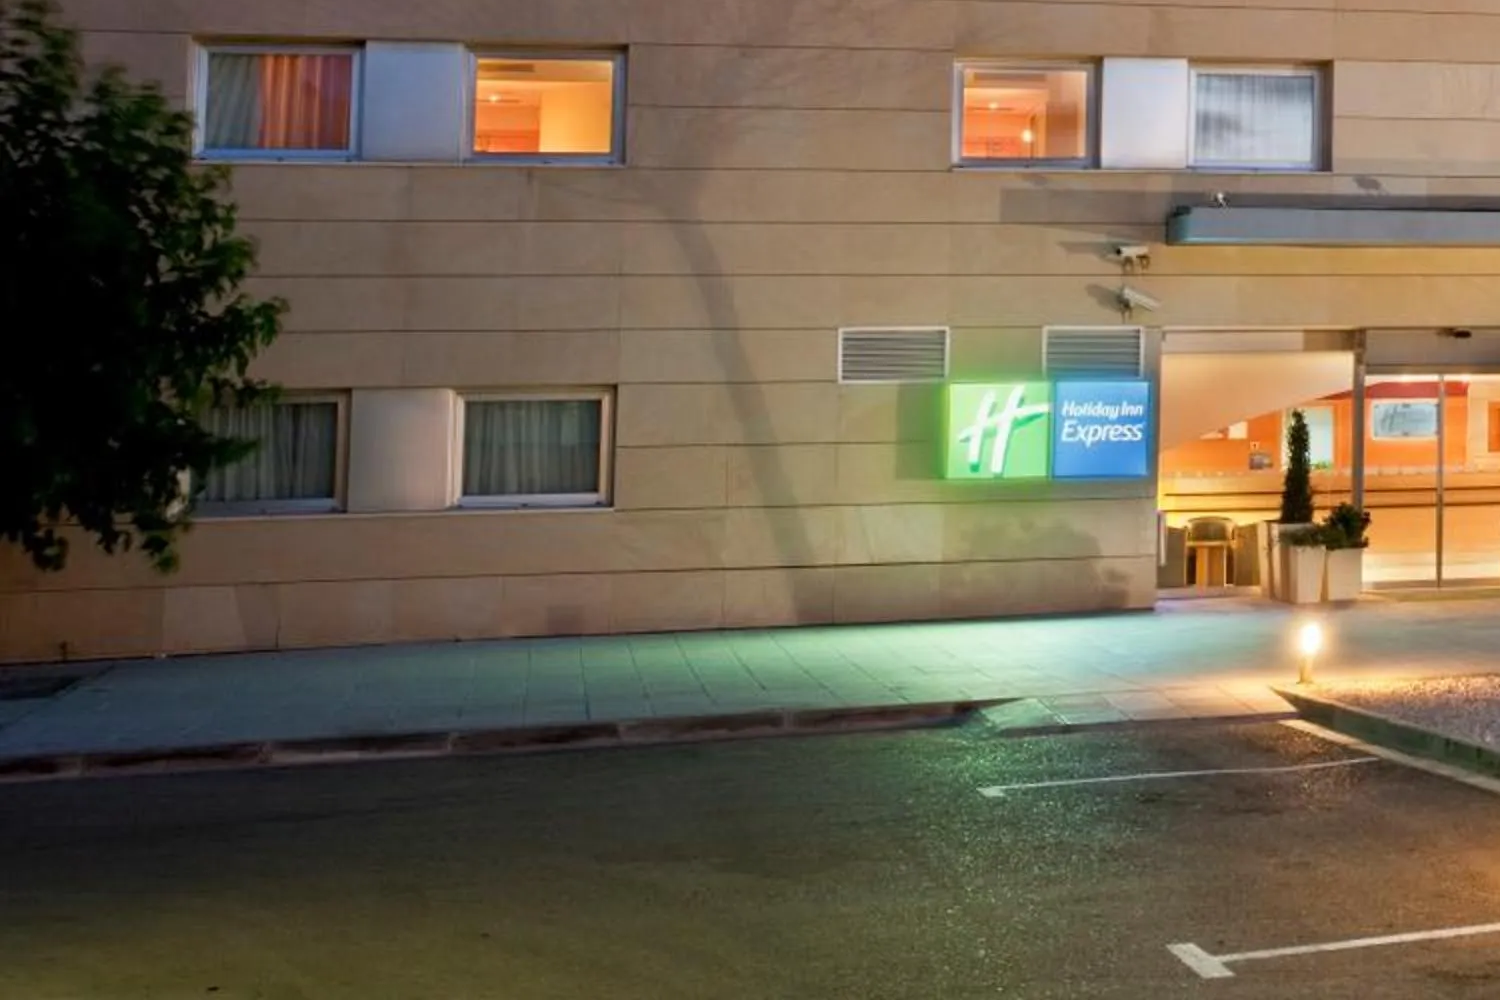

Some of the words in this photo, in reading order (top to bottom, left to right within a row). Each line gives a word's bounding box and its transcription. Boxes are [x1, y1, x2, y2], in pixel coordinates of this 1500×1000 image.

[1061, 400, 1119, 420] Holiday
[1120, 400, 1143, 416] Inn
[1061, 419, 1144, 448] Express
